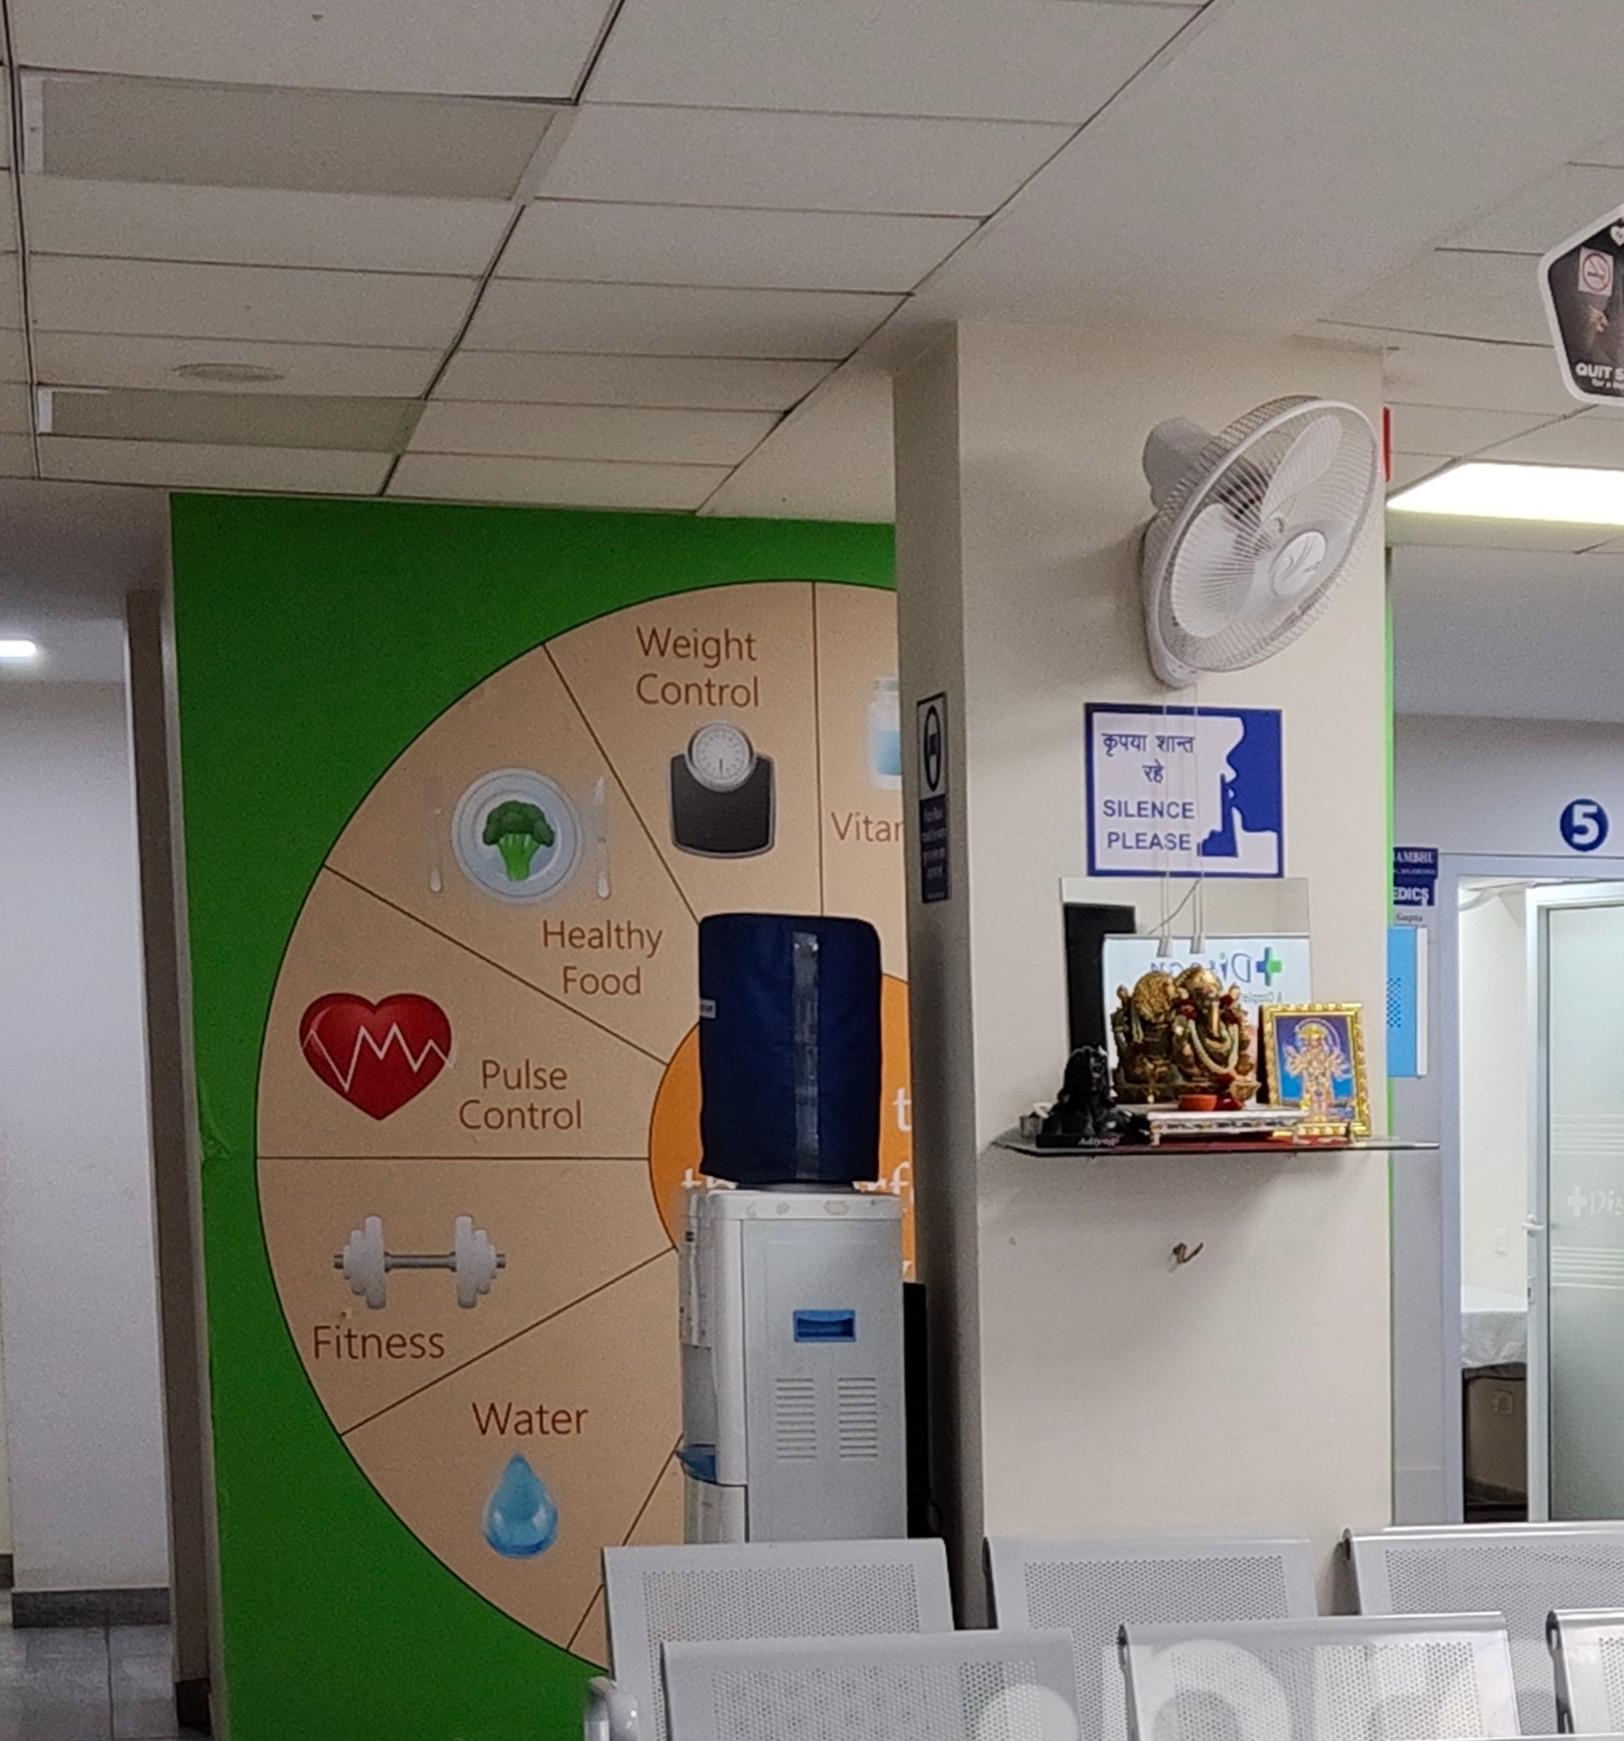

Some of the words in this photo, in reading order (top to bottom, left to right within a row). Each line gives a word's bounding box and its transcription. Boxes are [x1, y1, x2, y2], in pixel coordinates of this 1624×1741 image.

[1576, 363, 1613, 380] QUIT
[636, 625, 758, 665] Weight
[636, 674, 760, 708] Control
[1101, 732, 1147, 757] कृपया
[1156, 735, 1195, 753] शान्त
[1103, 800, 1195, 819] SILENCE
[1573, 805, 1599, 844] 5
[1107, 831, 1192, 850] PLEASE
[541, 919, 664, 959] Healthy
[562, 965, 642, 996] Food
[481, 1058, 569, 1091] Pulse
[458, 1099, 582, 1130] Control
[312, 1324, 445, 1361] Fitness
[473, 1401, 589, 1438] Water
